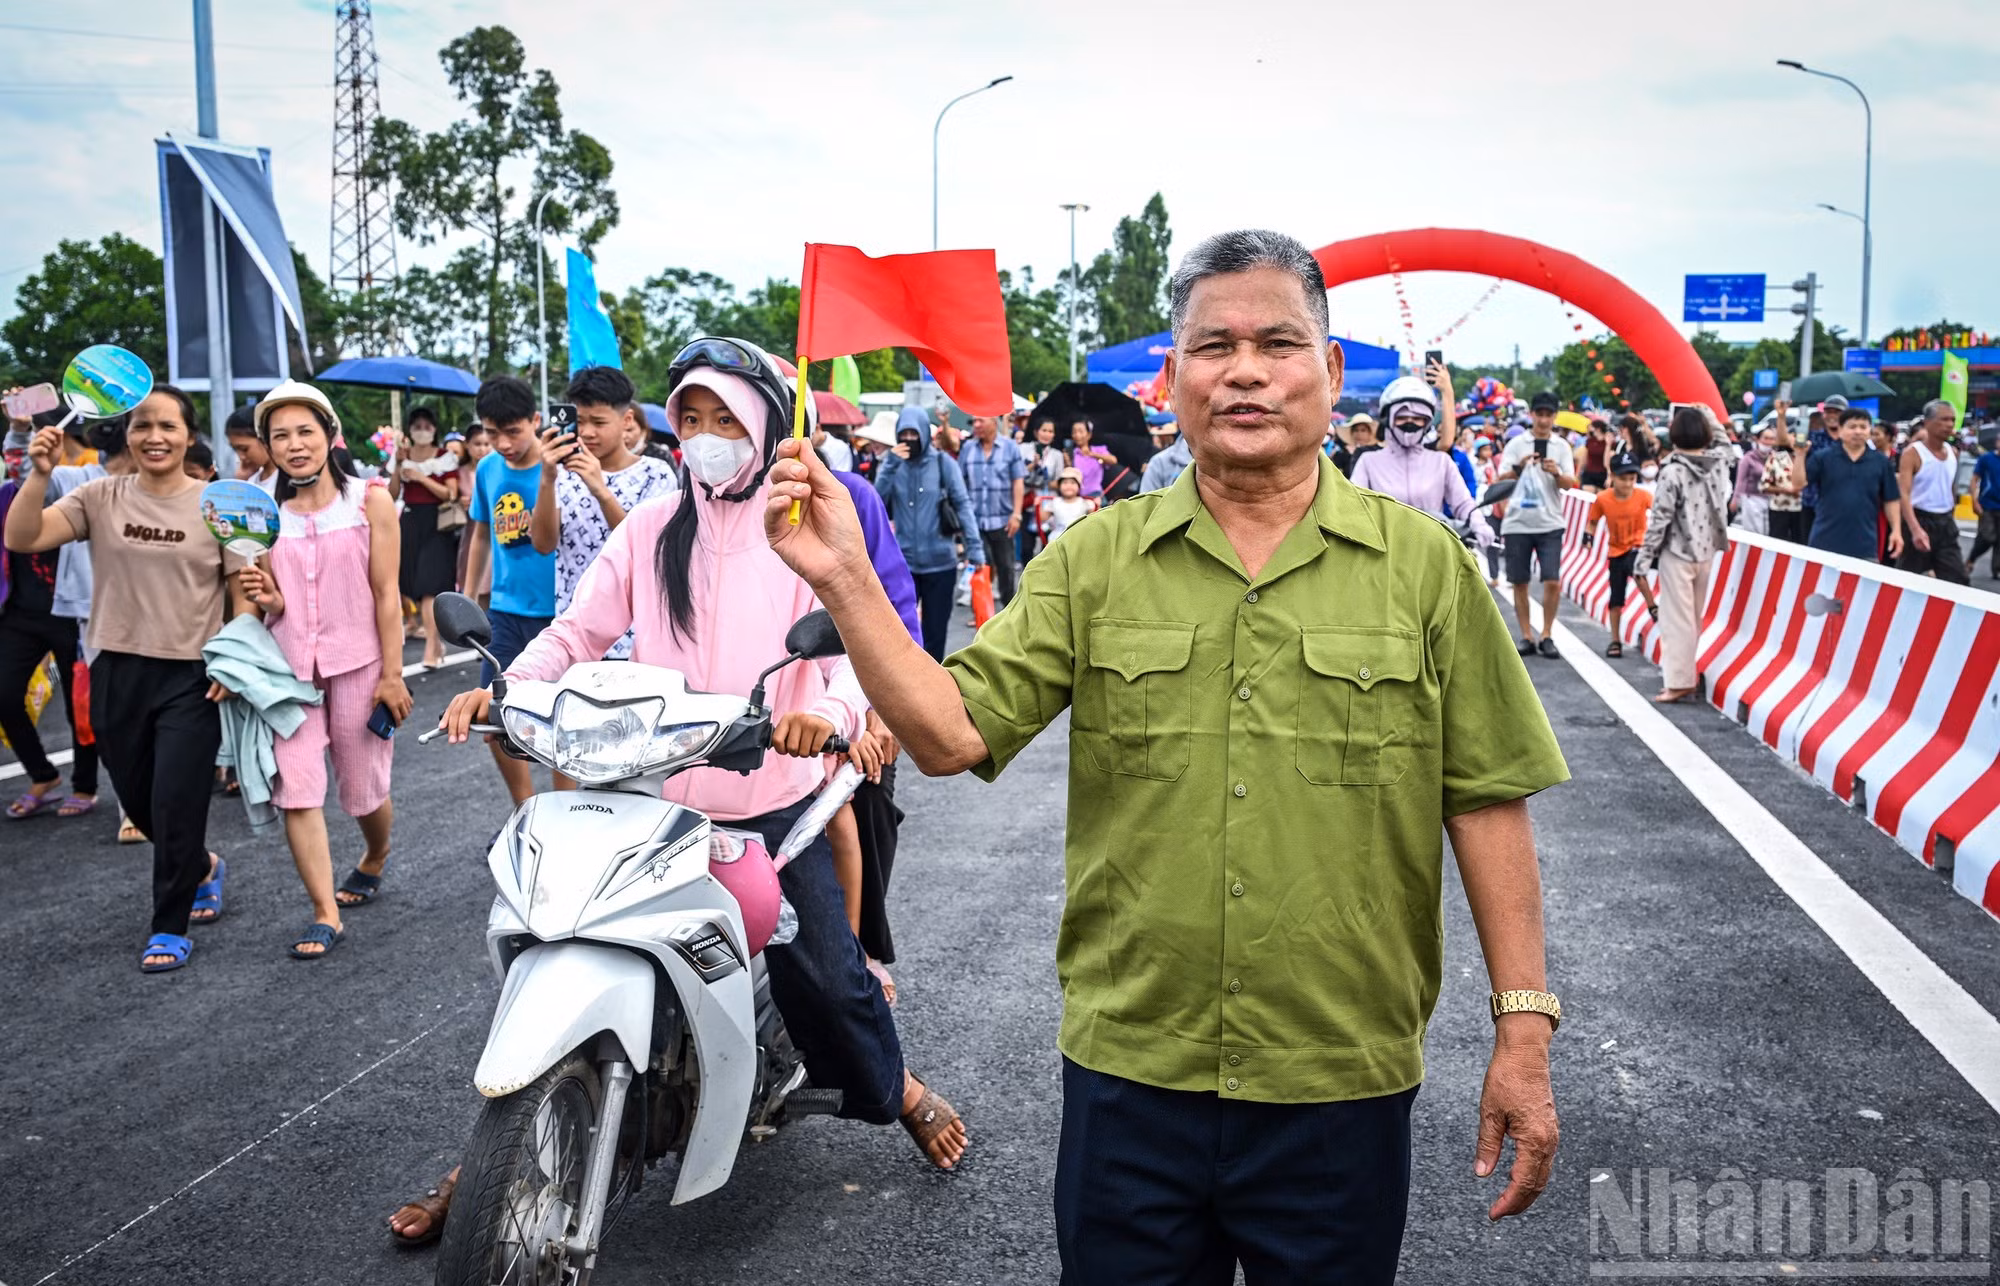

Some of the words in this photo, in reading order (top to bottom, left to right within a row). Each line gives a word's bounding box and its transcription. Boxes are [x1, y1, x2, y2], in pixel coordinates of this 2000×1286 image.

[123, 523, 186, 543] WOLRD
[569, 804, 615, 815] HONDA
[692, 935, 722, 952] HONDA
